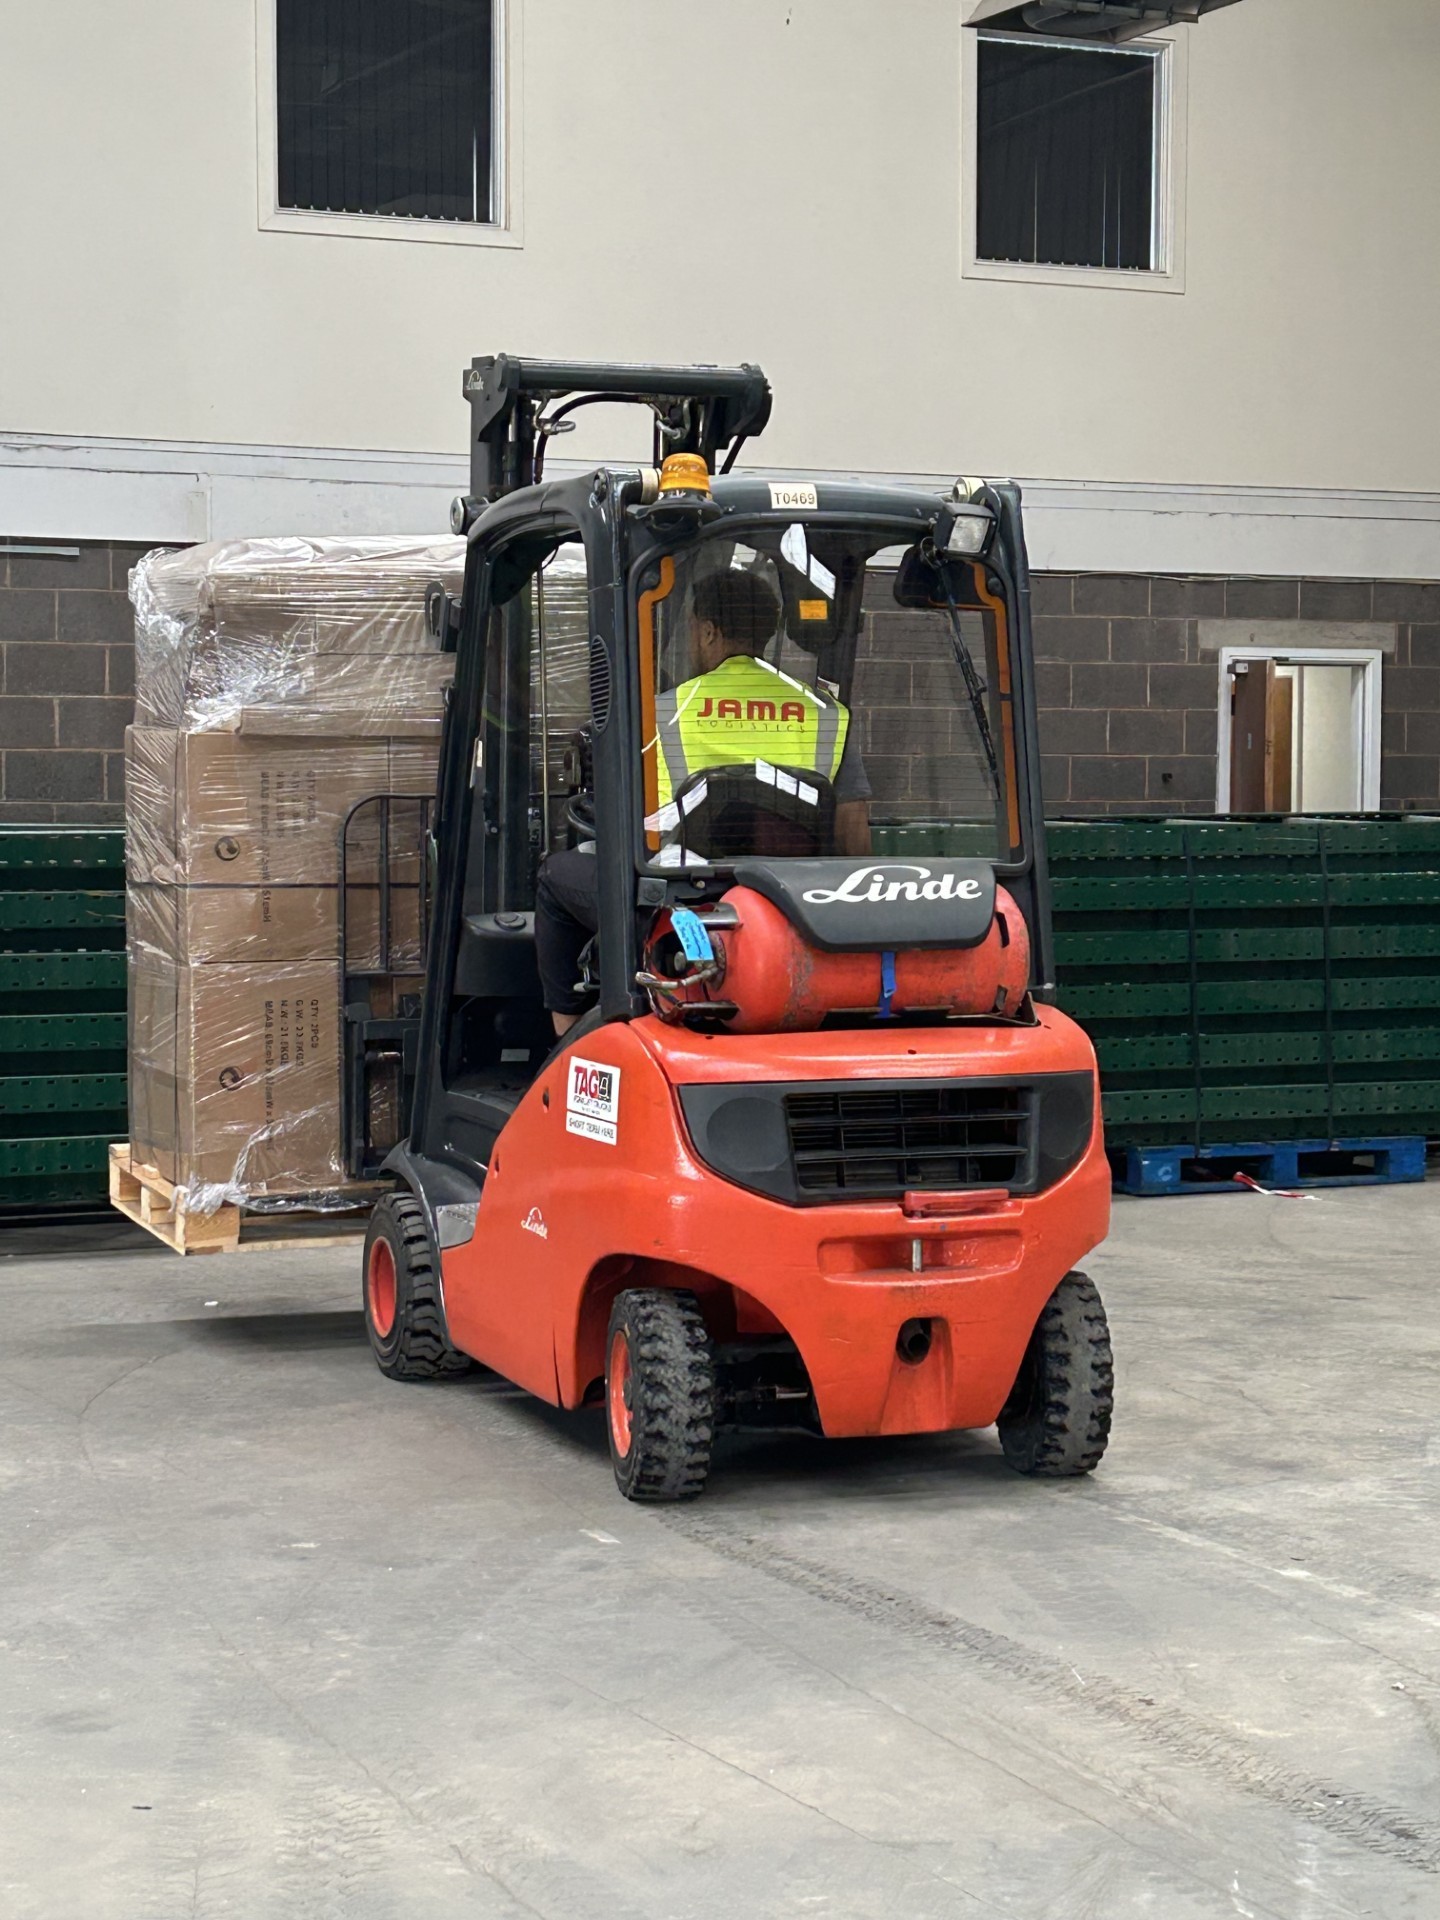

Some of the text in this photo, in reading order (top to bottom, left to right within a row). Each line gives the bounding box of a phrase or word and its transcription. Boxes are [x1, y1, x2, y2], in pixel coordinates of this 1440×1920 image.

[773, 492, 815, 505] T0469
[697, 697, 805, 723] JAMA
[802, 865, 982, 904] Linde
[574, 1065, 599, 1099] TAG
